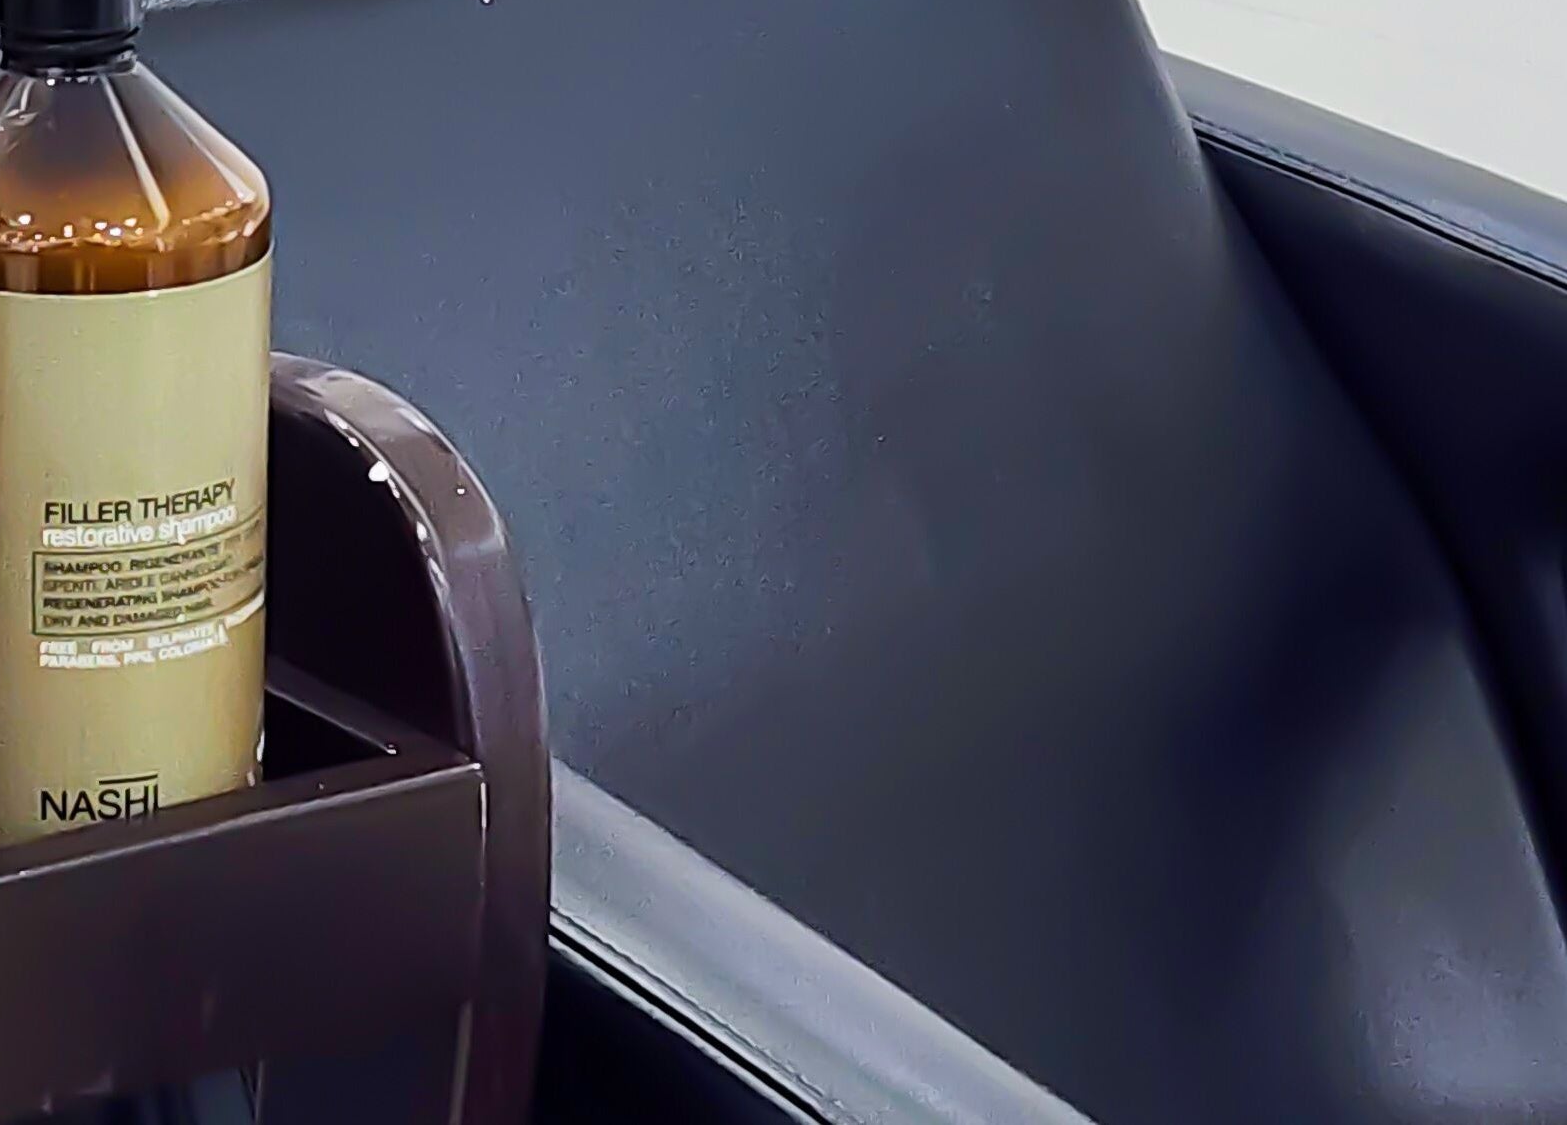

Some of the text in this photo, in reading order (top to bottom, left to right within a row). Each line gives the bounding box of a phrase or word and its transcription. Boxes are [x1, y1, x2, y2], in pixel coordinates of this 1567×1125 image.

[44, 477, 235, 524] FILLER THERAPY
[42, 521, 154, 548] restorative
[158, 505, 238, 545] shampoo
[40, 783, 159, 822] NASHI
